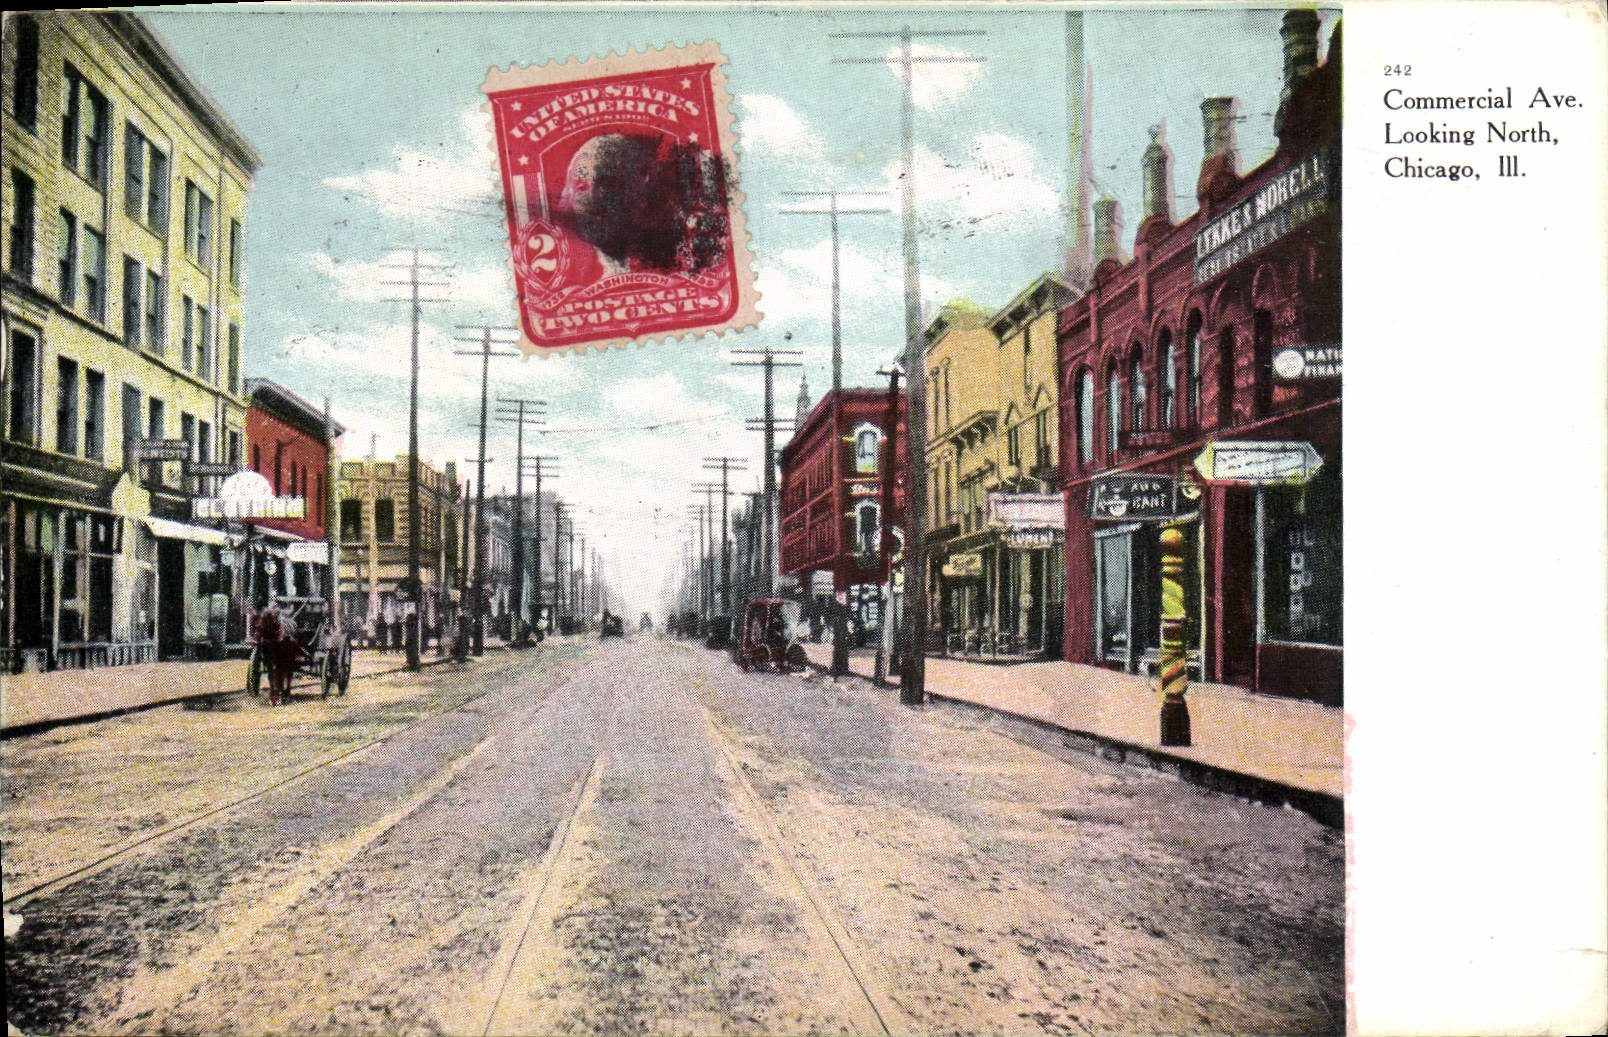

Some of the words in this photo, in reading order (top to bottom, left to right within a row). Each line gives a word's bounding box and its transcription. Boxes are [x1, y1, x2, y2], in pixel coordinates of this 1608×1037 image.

[510, 88, 600, 139] UNITED
[604, 84, 700, 117] STATES
[529, 116, 561, 142] OF
[562, 99, 679, 123] AMERICA
[527, 233, 558, 274] 2
[562, 286, 697, 314] POSTAGE
[585, 273, 669, 298] WASHINGTON
[541, 310, 611, 331] TWO
[613, 295, 721, 321] CENTS
